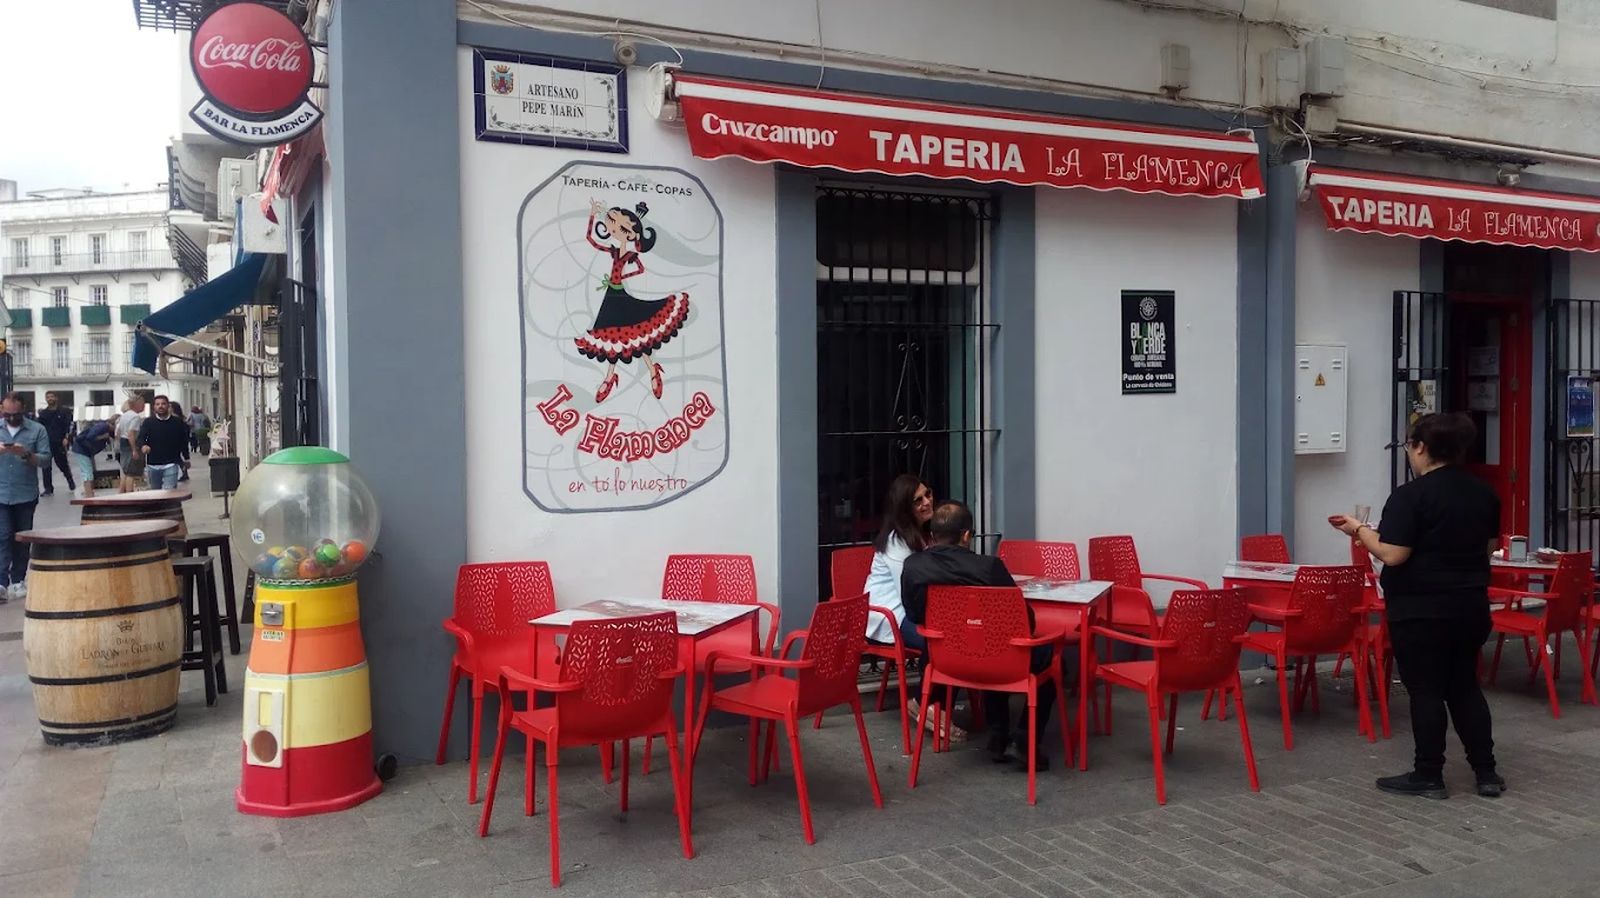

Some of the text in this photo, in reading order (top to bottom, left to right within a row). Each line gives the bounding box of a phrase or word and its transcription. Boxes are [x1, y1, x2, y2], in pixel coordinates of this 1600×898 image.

[198, 35, 304, 72] Coca-Cola
[527, 83, 579, 100] ARTESANO
[203, 108, 314, 136] BAR LA FLAMENCA
[522, 100, 584, 118] PEPE MARÍN
[701, 111, 1246, 190] Cruzcampo TAPERIA LA FLAMENCA
[655, 183, 693, 197] COPAS
[1327, 196, 1435, 229] TAPERIA
[1447, 207, 1471, 233] LA
[1483, 211, 1583, 242] FLAMENCA
[1123, 372, 1144, 381] Punto
[1145, 372, 1154, 380] de
[536, 383, 716, 463] La Flamenca
[568, 480, 586, 493] en
[614, 467, 626, 496] lo
[631, 475, 688, 492] nuestro
